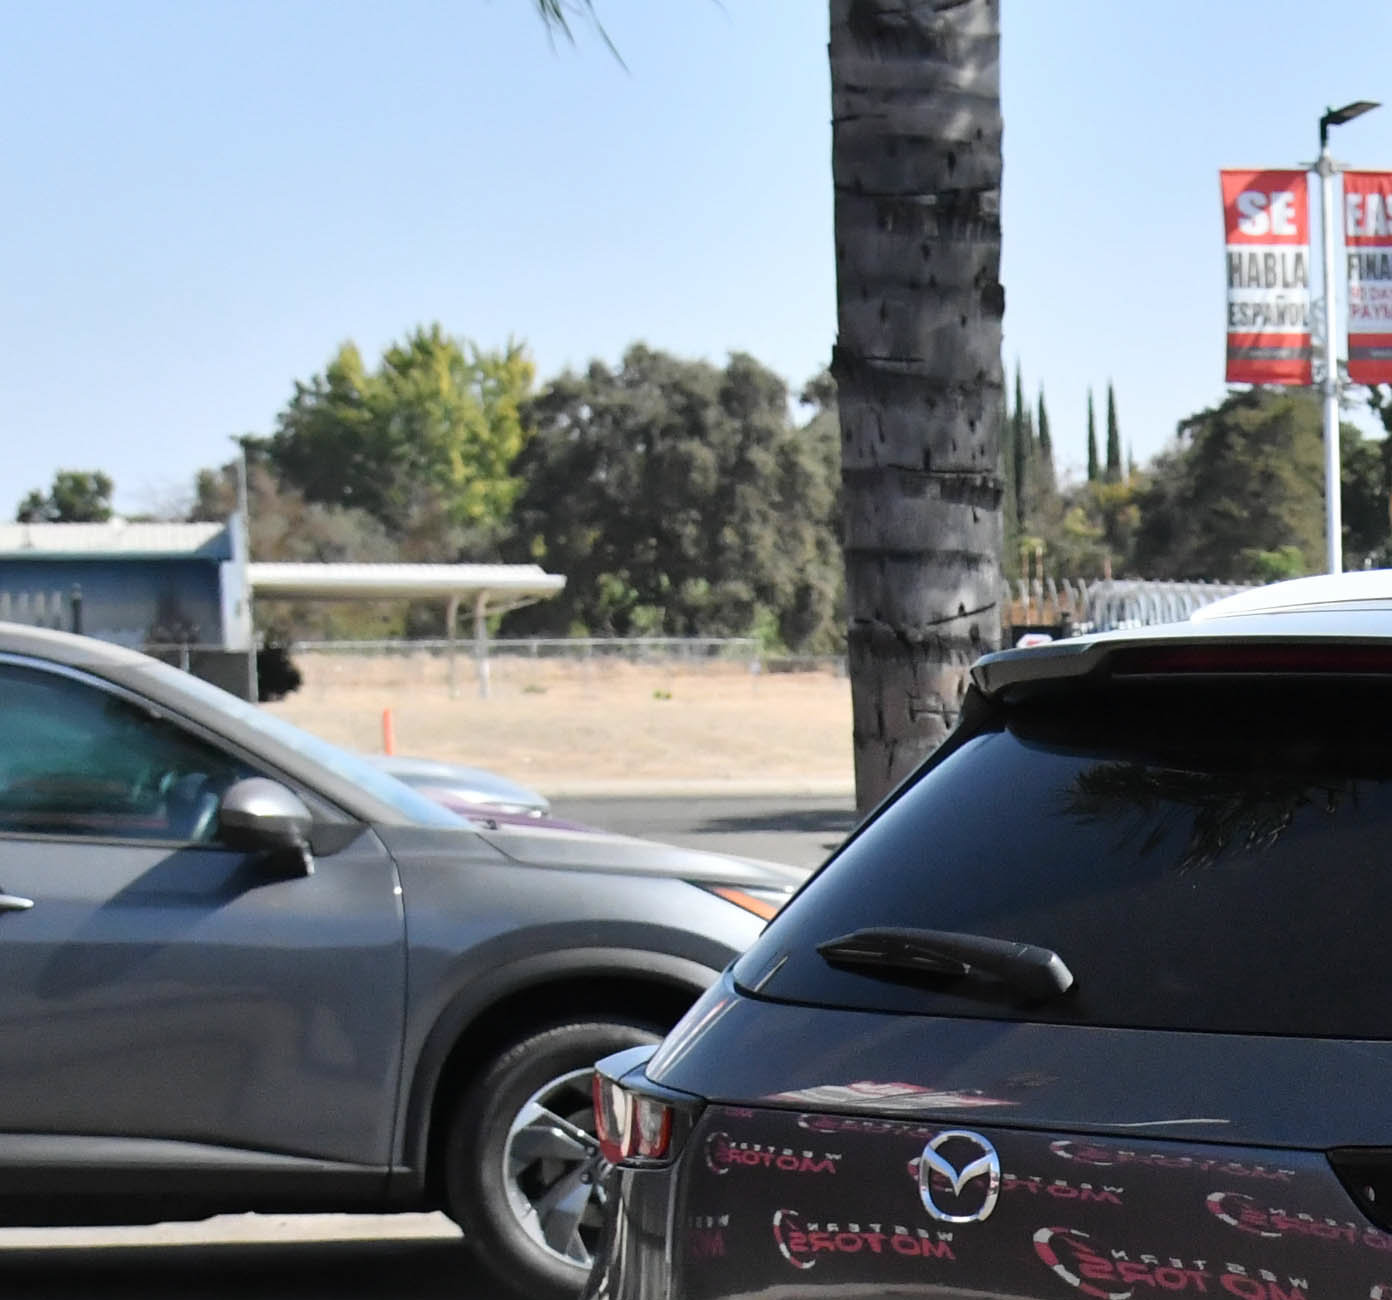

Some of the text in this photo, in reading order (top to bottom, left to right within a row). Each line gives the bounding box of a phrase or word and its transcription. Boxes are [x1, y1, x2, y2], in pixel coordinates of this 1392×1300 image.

[1236, 191, 1297, 236] SE
[1229, 252, 1307, 288] HABLA
[1228, 295, 1308, 327] ESPAÑOL
